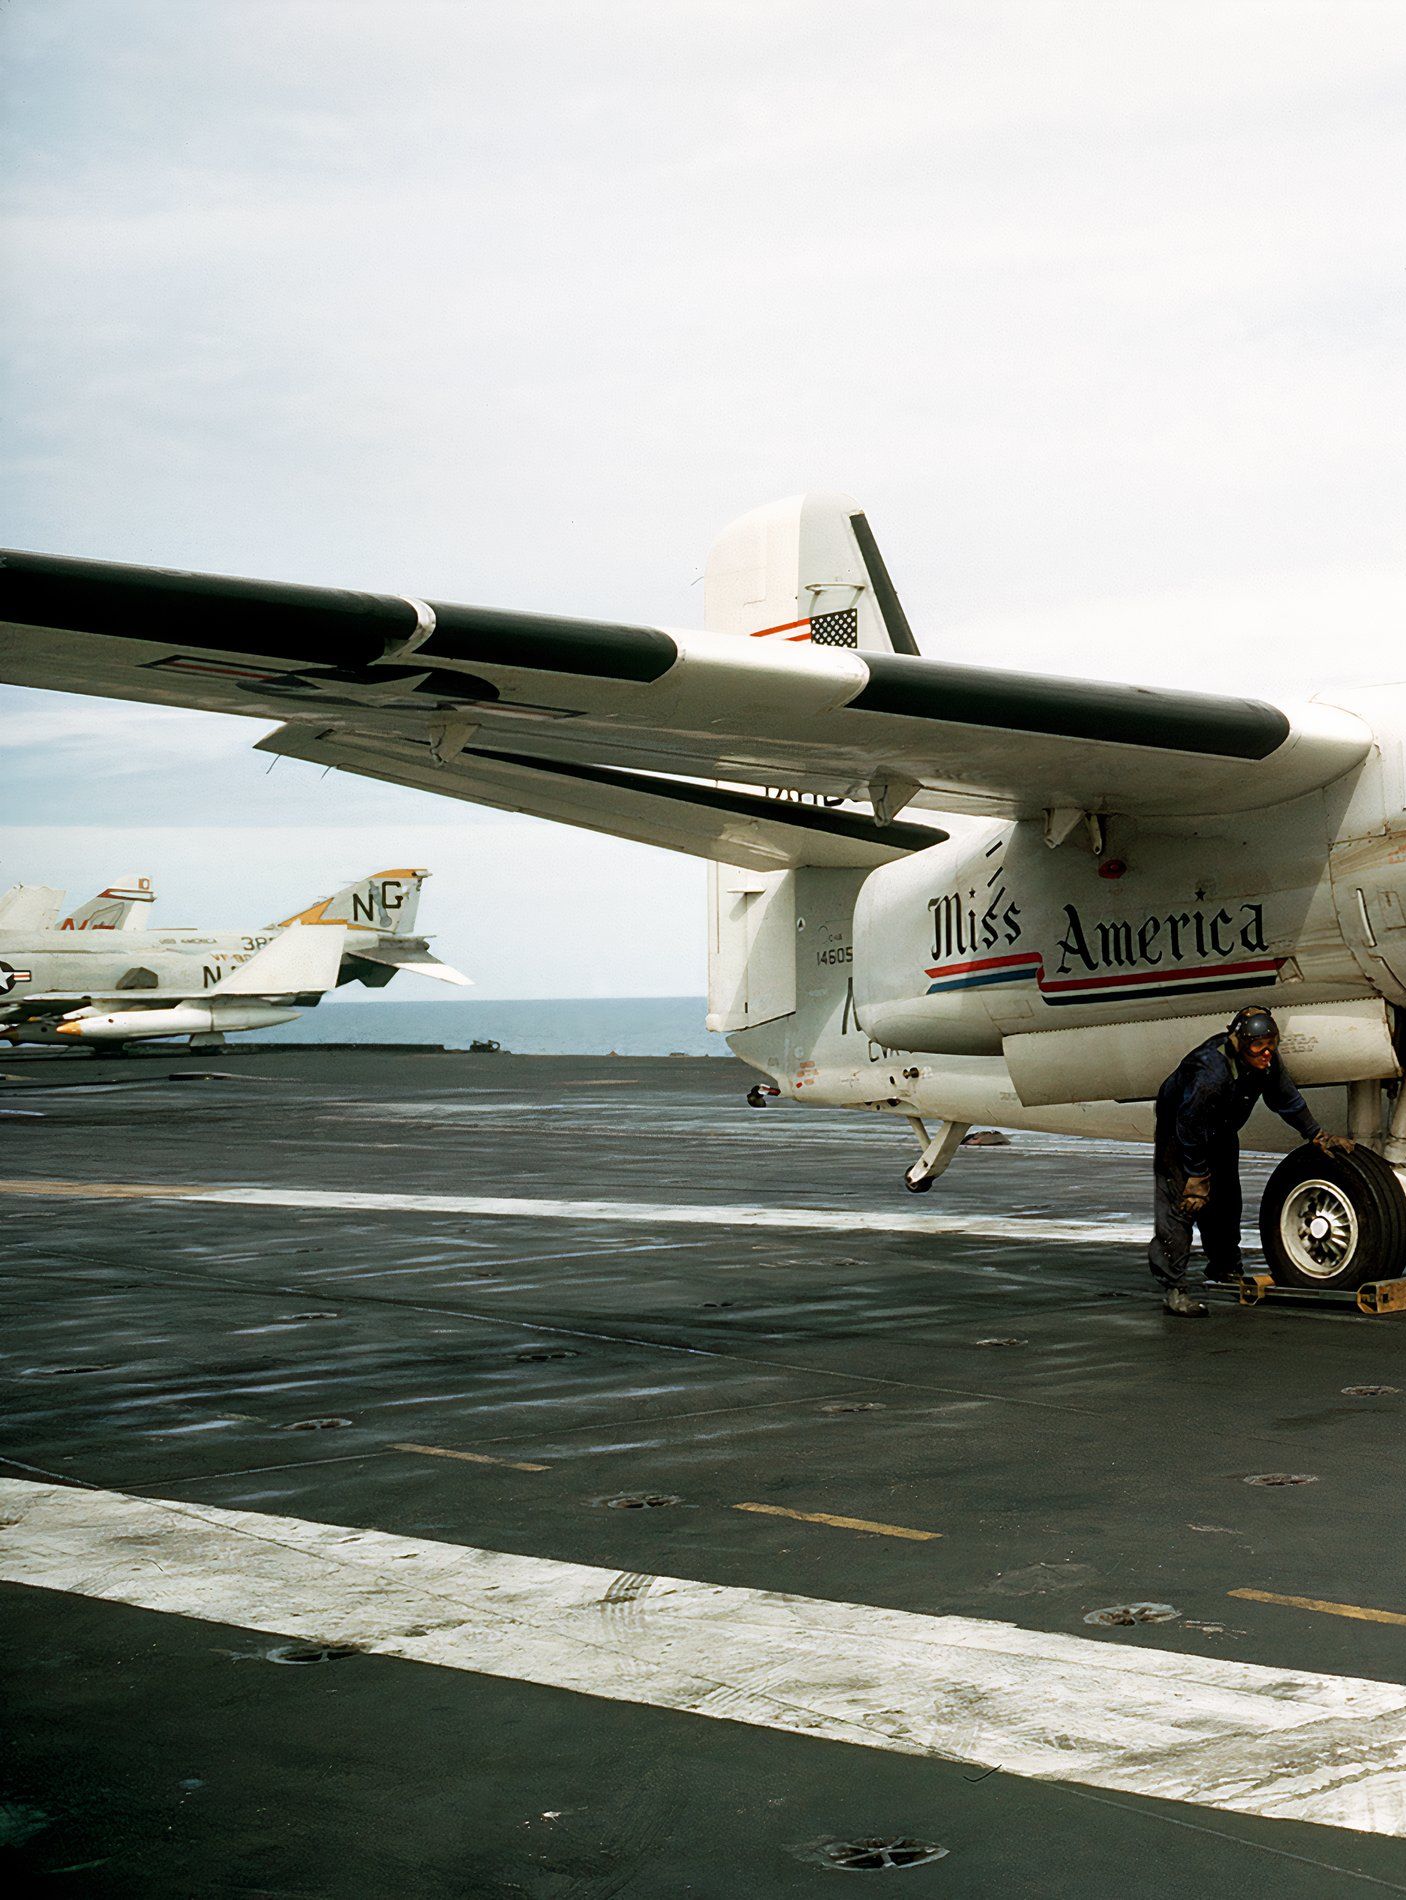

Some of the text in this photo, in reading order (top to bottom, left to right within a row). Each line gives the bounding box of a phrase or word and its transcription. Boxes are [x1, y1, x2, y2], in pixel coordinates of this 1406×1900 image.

[353, 881, 404, 921] NG
[928, 887, 1269, 975] Miss America
